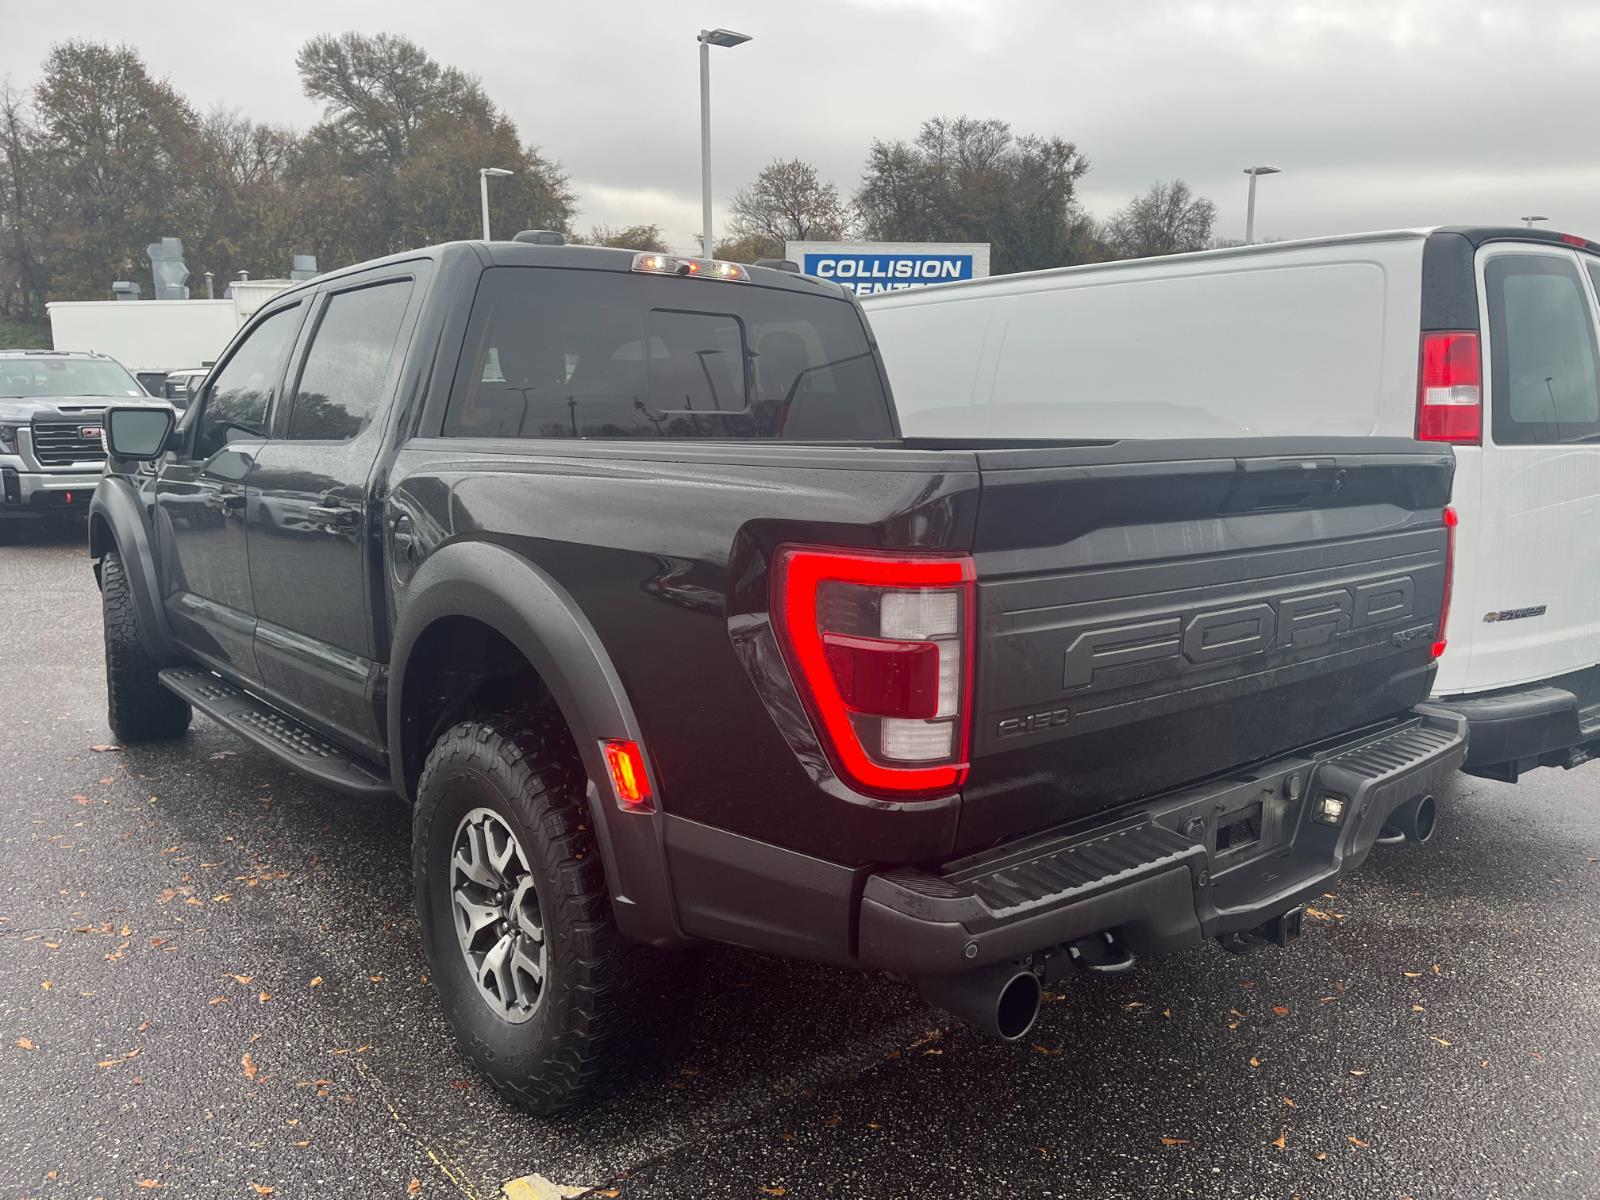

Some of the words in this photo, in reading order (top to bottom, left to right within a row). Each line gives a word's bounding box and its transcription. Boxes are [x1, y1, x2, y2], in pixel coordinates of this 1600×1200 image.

[816, 259, 962, 278] COLLISION
[840, 282, 940, 297] CENT
[1063, 576, 1417, 690] FORD
